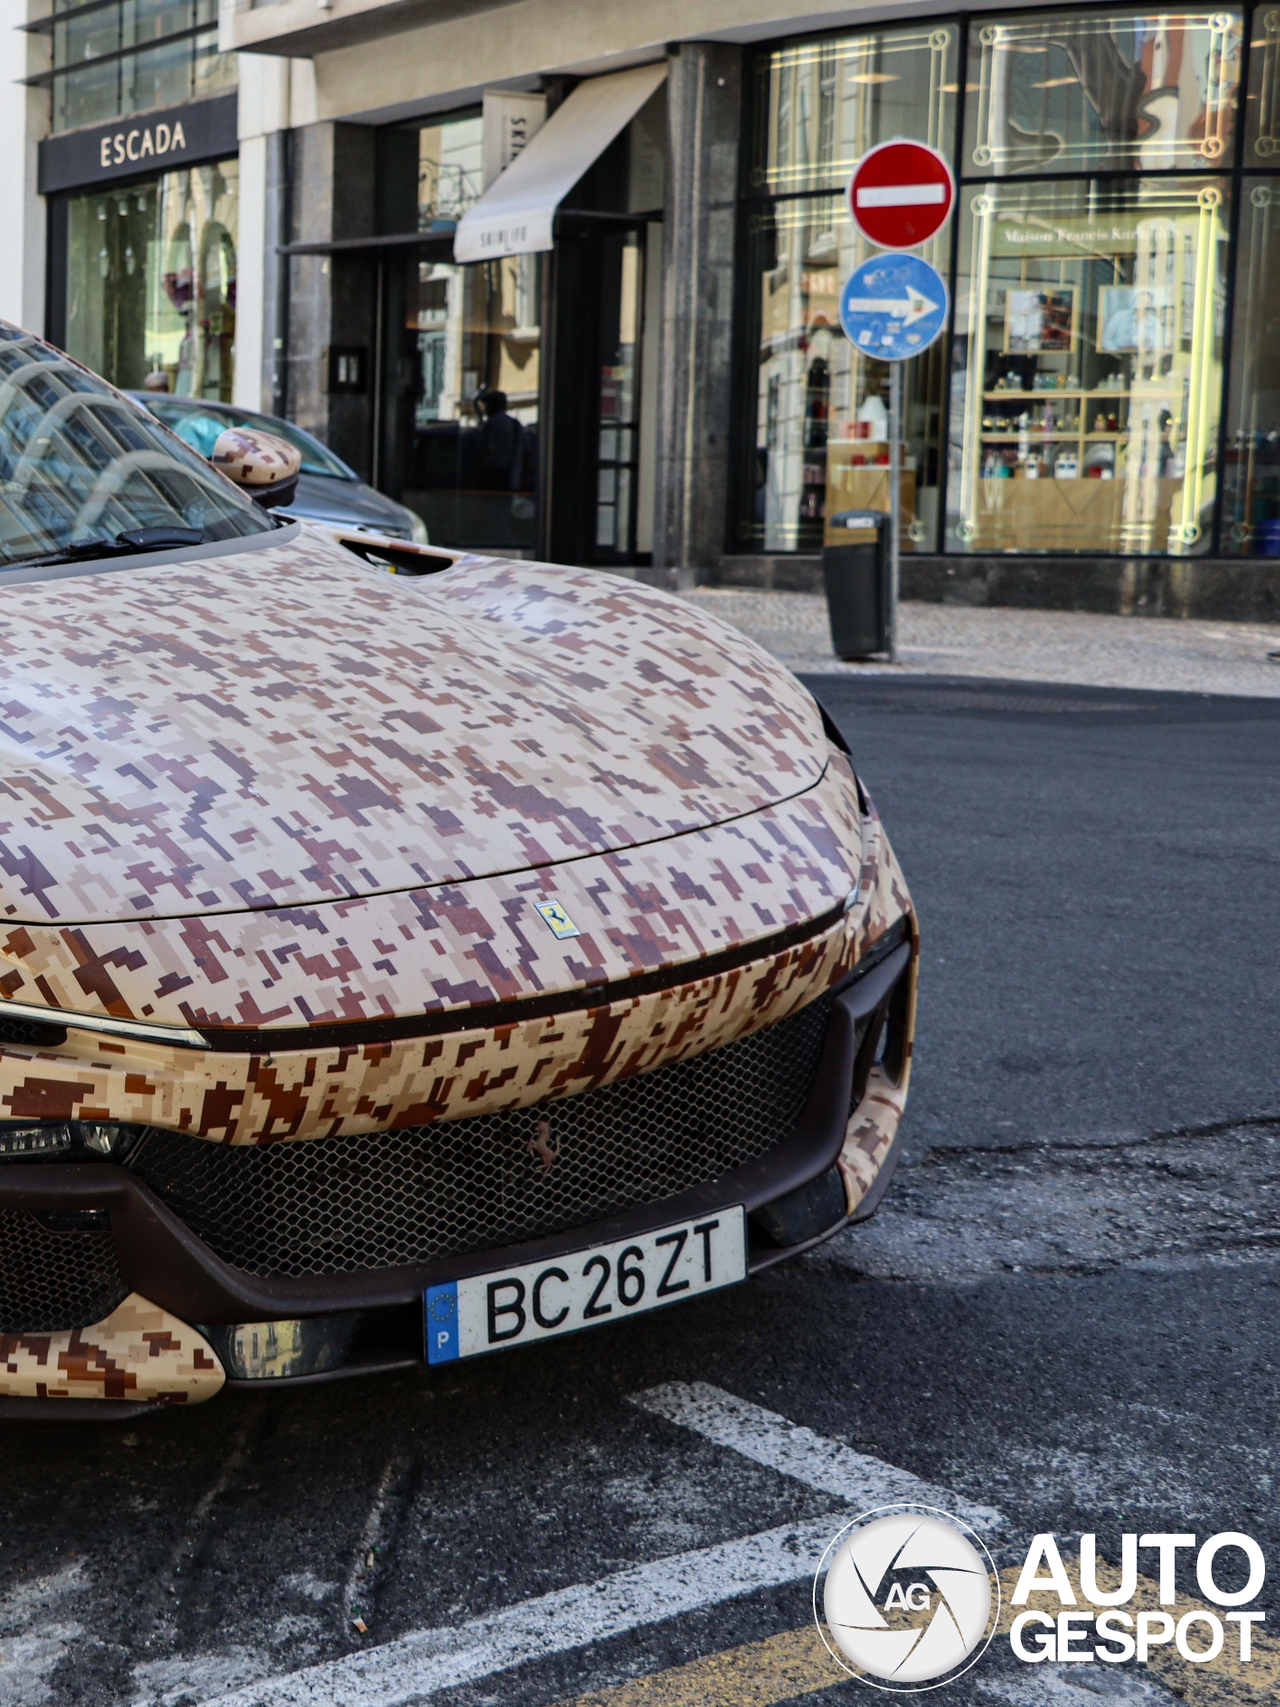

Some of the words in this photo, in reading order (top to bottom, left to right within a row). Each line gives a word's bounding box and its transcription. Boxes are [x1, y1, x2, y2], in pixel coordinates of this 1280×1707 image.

[100, 121, 187, 168] ESCADA
[1004, 229, 1053, 244] Maison
[1057, 228, 1109, 243] Francis
[437, 1331, 450, 1349] P
